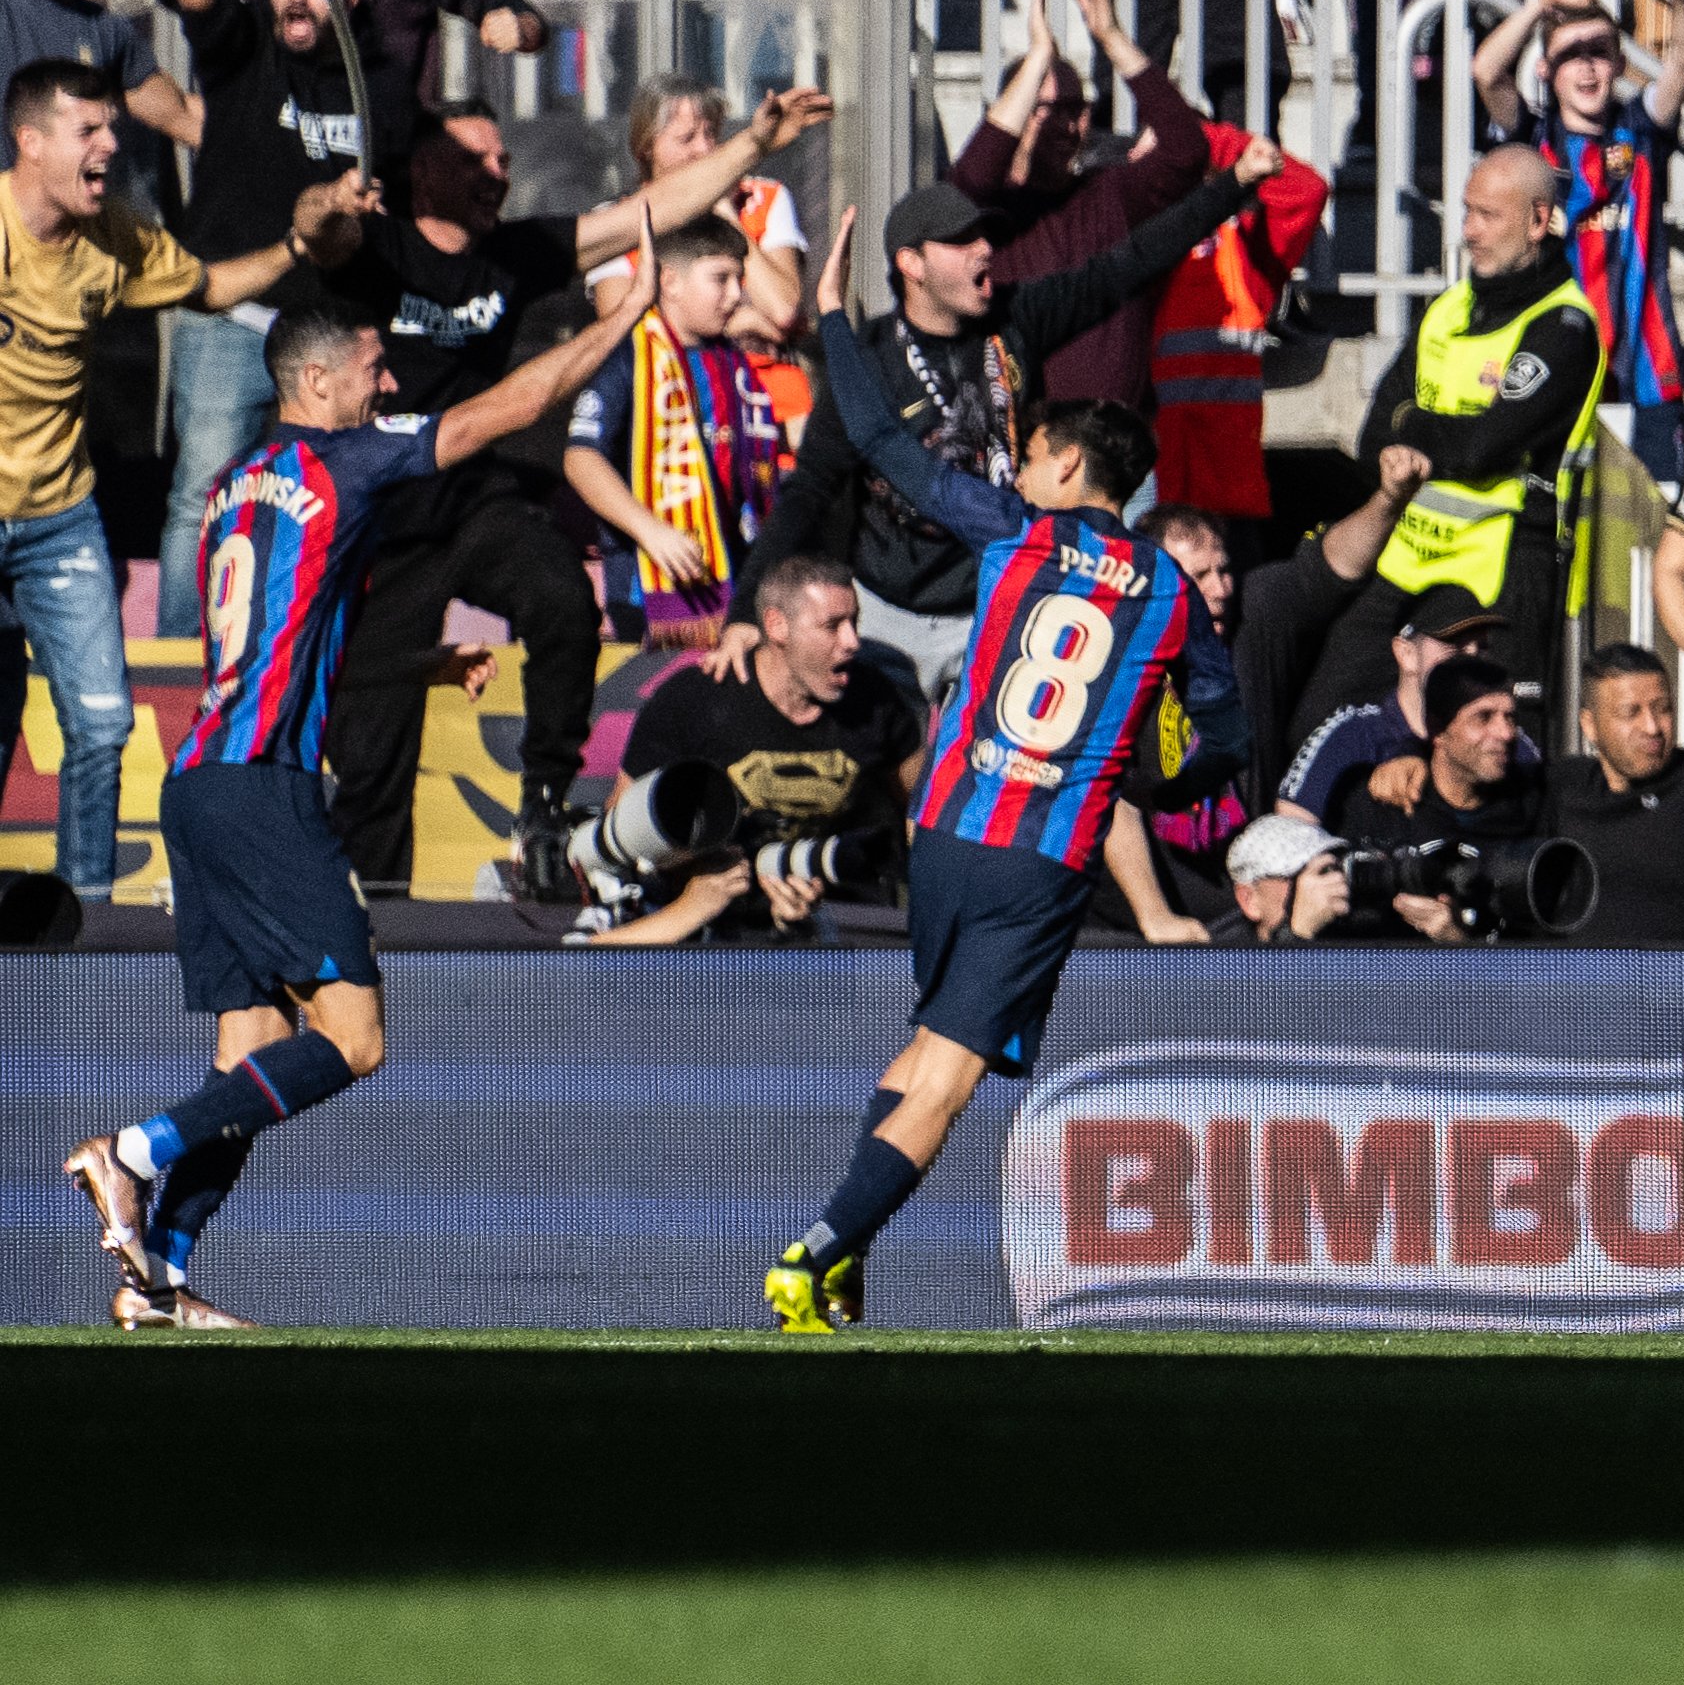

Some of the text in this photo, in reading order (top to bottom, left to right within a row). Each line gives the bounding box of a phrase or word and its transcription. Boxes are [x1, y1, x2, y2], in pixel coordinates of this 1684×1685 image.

[206, 532, 256, 674] 9
[1059, 544, 1150, 597] PEDRI
[995, 592, 1115, 753] 8
